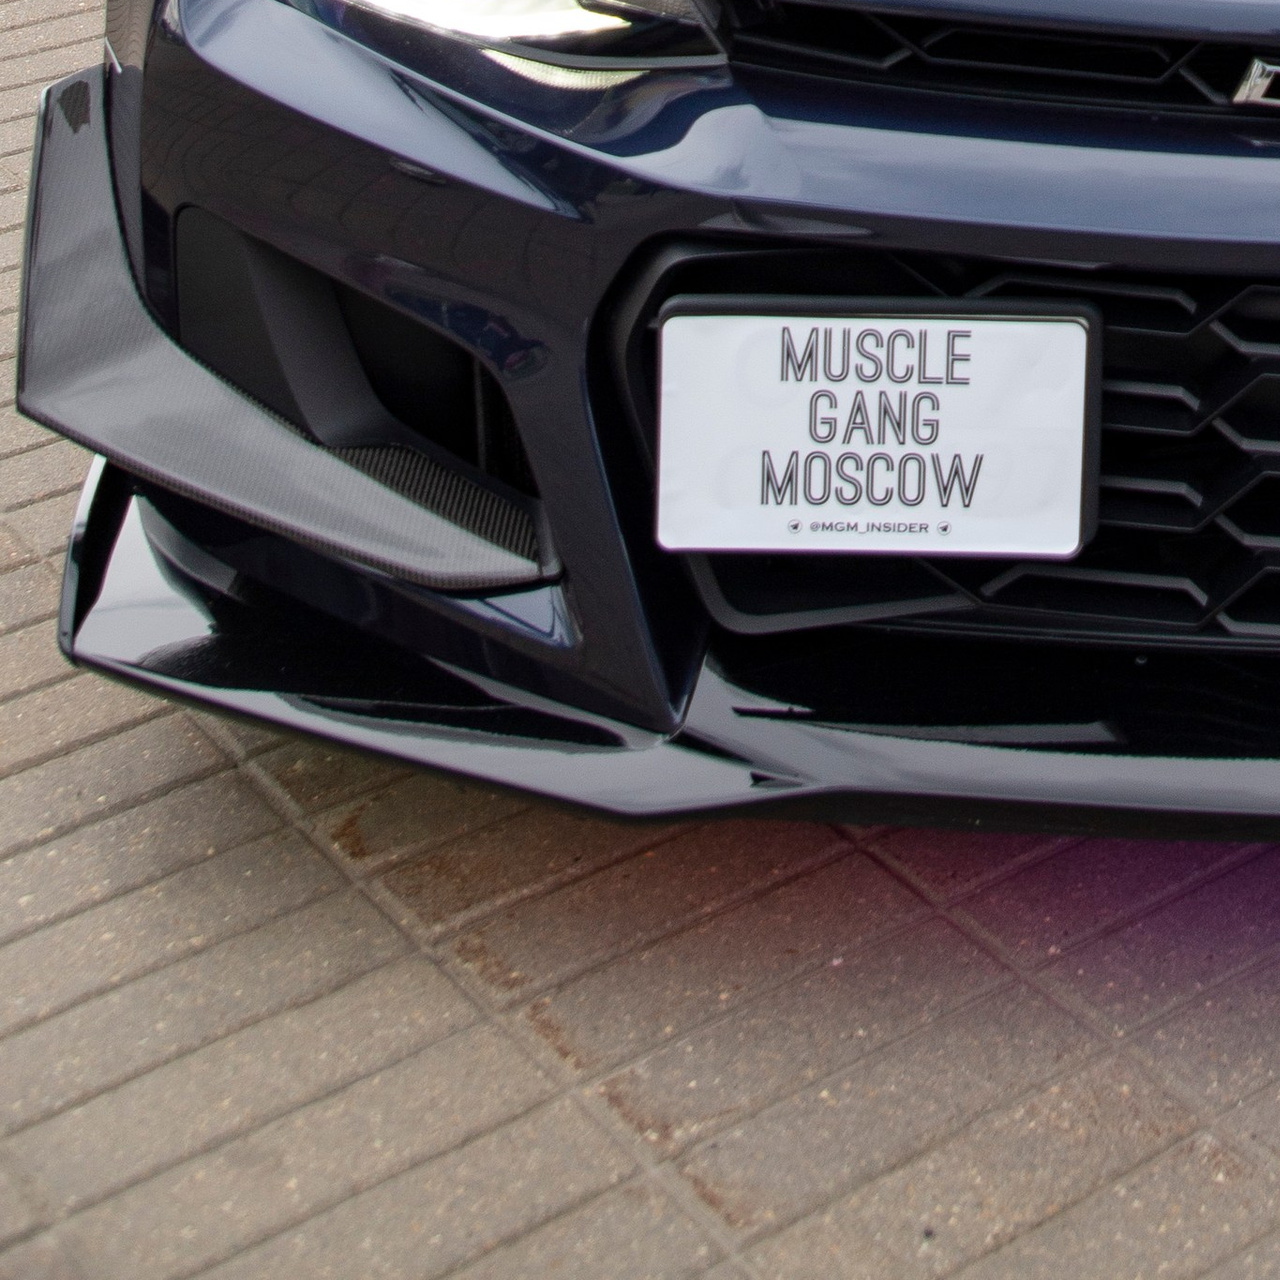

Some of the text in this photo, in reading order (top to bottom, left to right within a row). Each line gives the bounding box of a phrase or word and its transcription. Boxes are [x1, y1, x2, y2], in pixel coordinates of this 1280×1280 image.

[780, 326, 972, 385] MUSCLE
[808, 389, 940, 445] GANG
[760, 450, 984, 508] MOSCOW
[810, 521, 929, 535] @MGM_INSIDER
